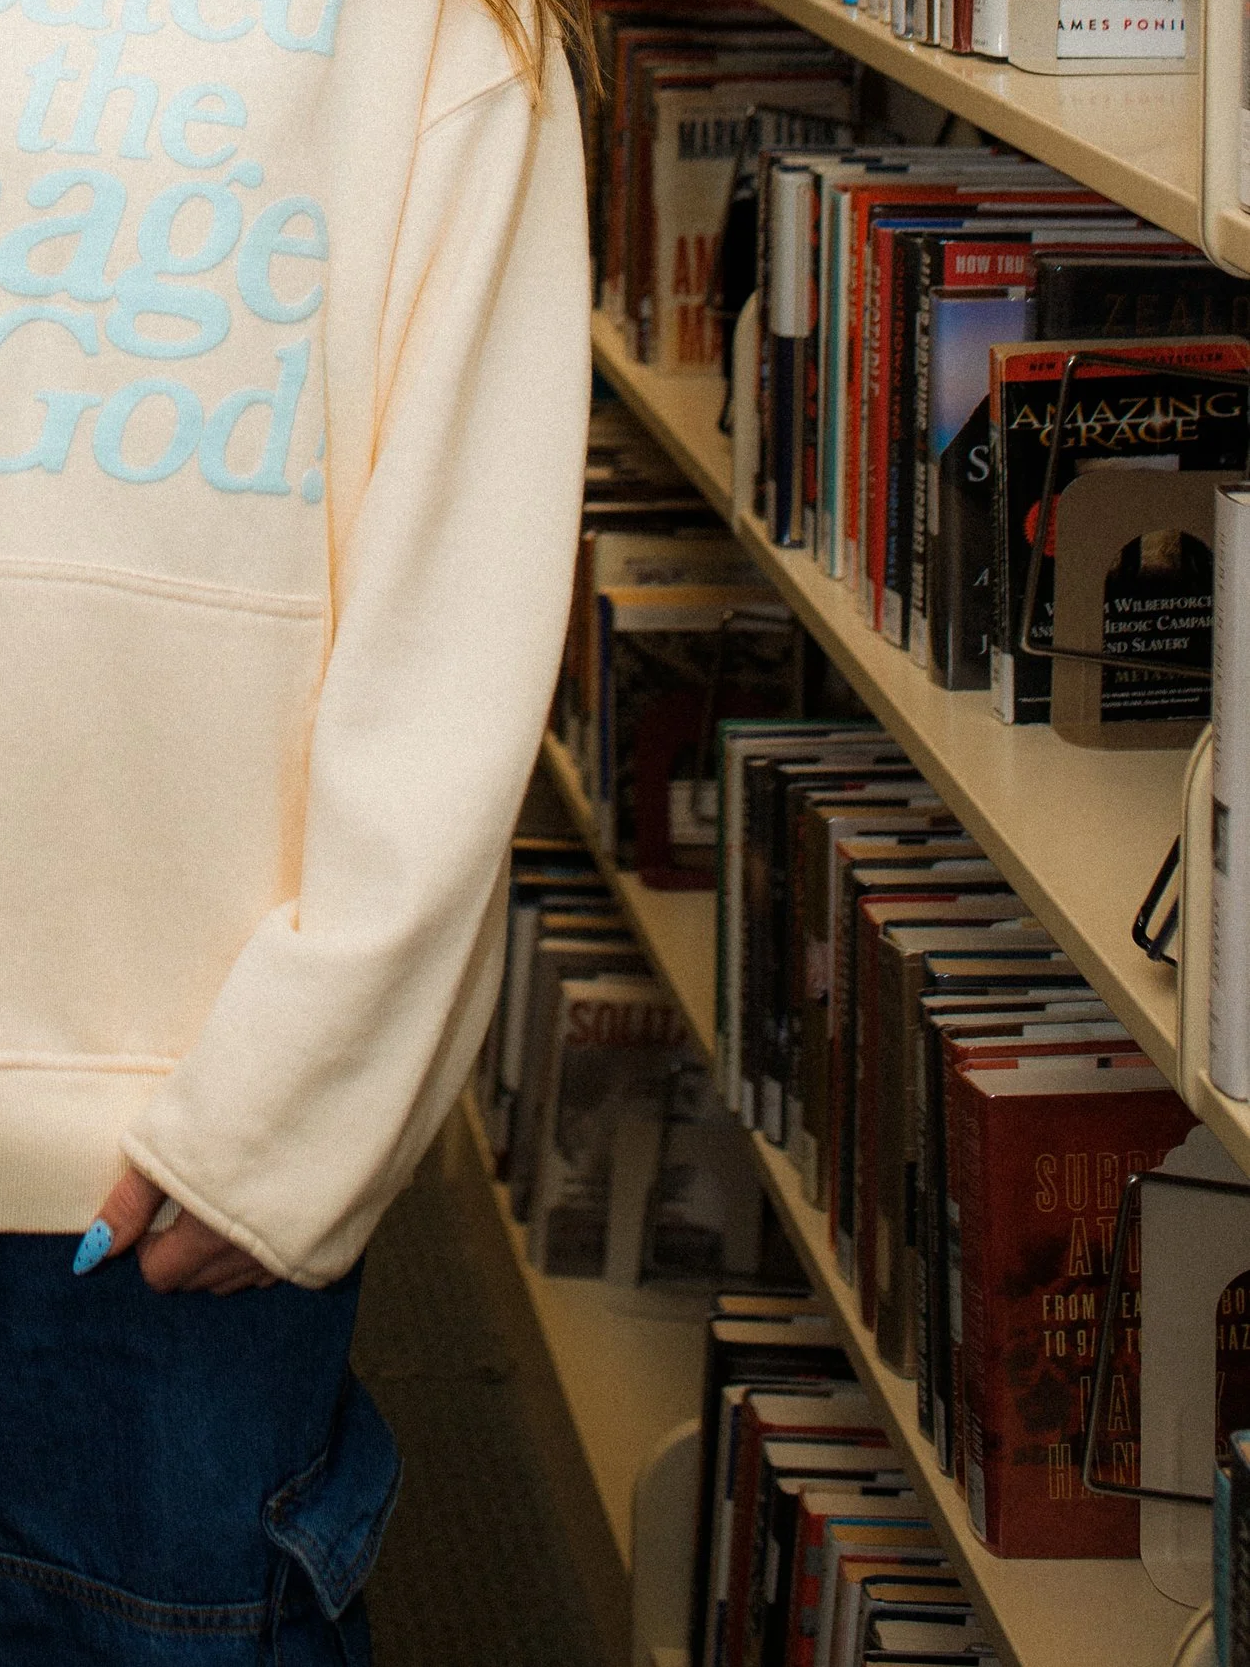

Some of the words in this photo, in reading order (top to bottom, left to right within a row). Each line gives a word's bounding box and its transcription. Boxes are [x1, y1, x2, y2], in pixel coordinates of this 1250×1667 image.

[16, 34, 248, 169] the
[955, 254, 991, 274] HOW
[1009, 391, 1243, 430] AMAZING
[1038, 417, 1200, 450] GRACE
[1131, 636, 1191, 653] SLAVERY
[1041, 1292, 1096, 1321] FROM
[1043, 1329, 1067, 1357] TO
